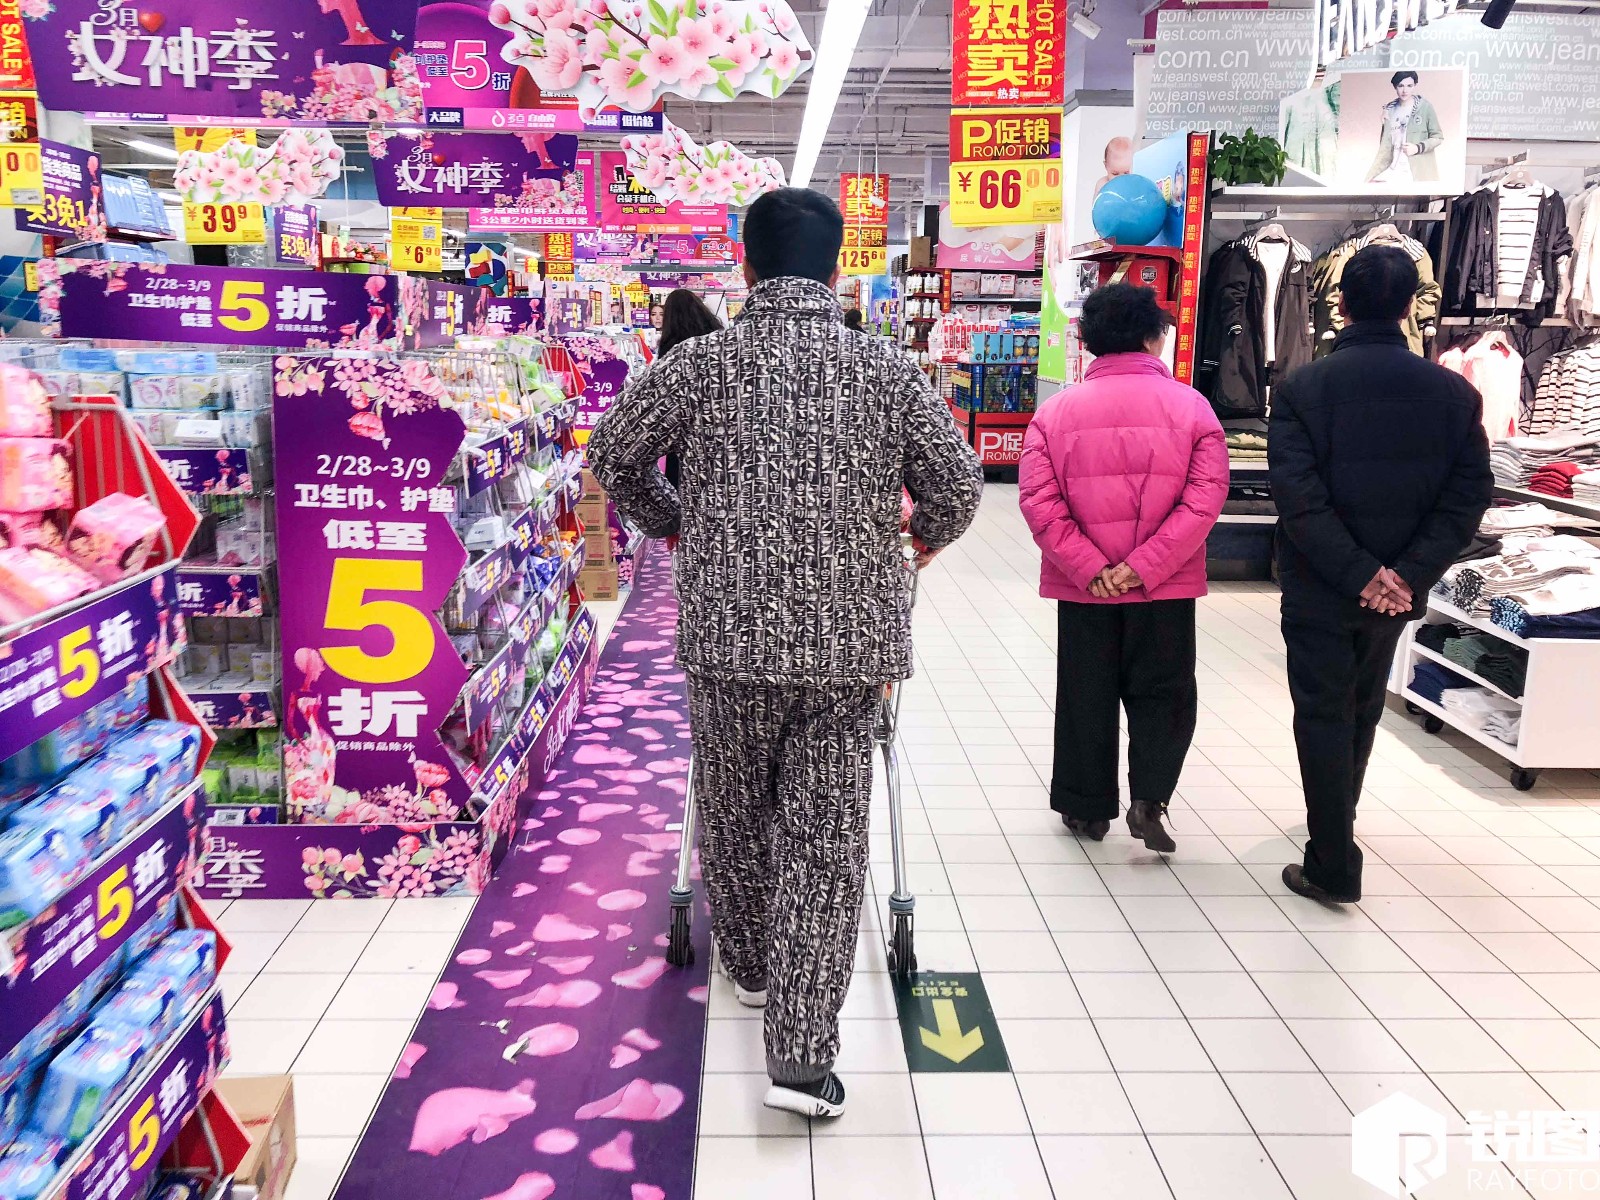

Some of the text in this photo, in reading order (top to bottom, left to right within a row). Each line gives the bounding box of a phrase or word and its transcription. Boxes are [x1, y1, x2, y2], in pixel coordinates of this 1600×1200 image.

[68, 21, 280, 90] 女神季
[450, 39, 511, 92] 5 折
[1033, 39, 1054, 86] SALE
[997, 88, 1020, 100] 热卖
[407, 146, 433, 162] 3月
[396, 159, 505, 194] 女神季
[845, 177, 873, 216] 热卖
[616, 195, 660, 204] 会员手机自
[180, 312, 213, 328] 低至
[217, 280, 328, 332] 5 折
[487, 305, 513, 323] 折
[317, 455, 431, 480] 2/28~3/9
[294, 483, 456, 513] 卫生巾、护垫
[322, 518, 428, 551] 低至
[319, 557, 436, 684] 5
[58, 625, 100, 699] 5
[328, 688, 428, 737] 折
[193, 849, 267, 898] 季
[97, 863, 135, 940] 5
[129, 1092, 161, 1172] 5
